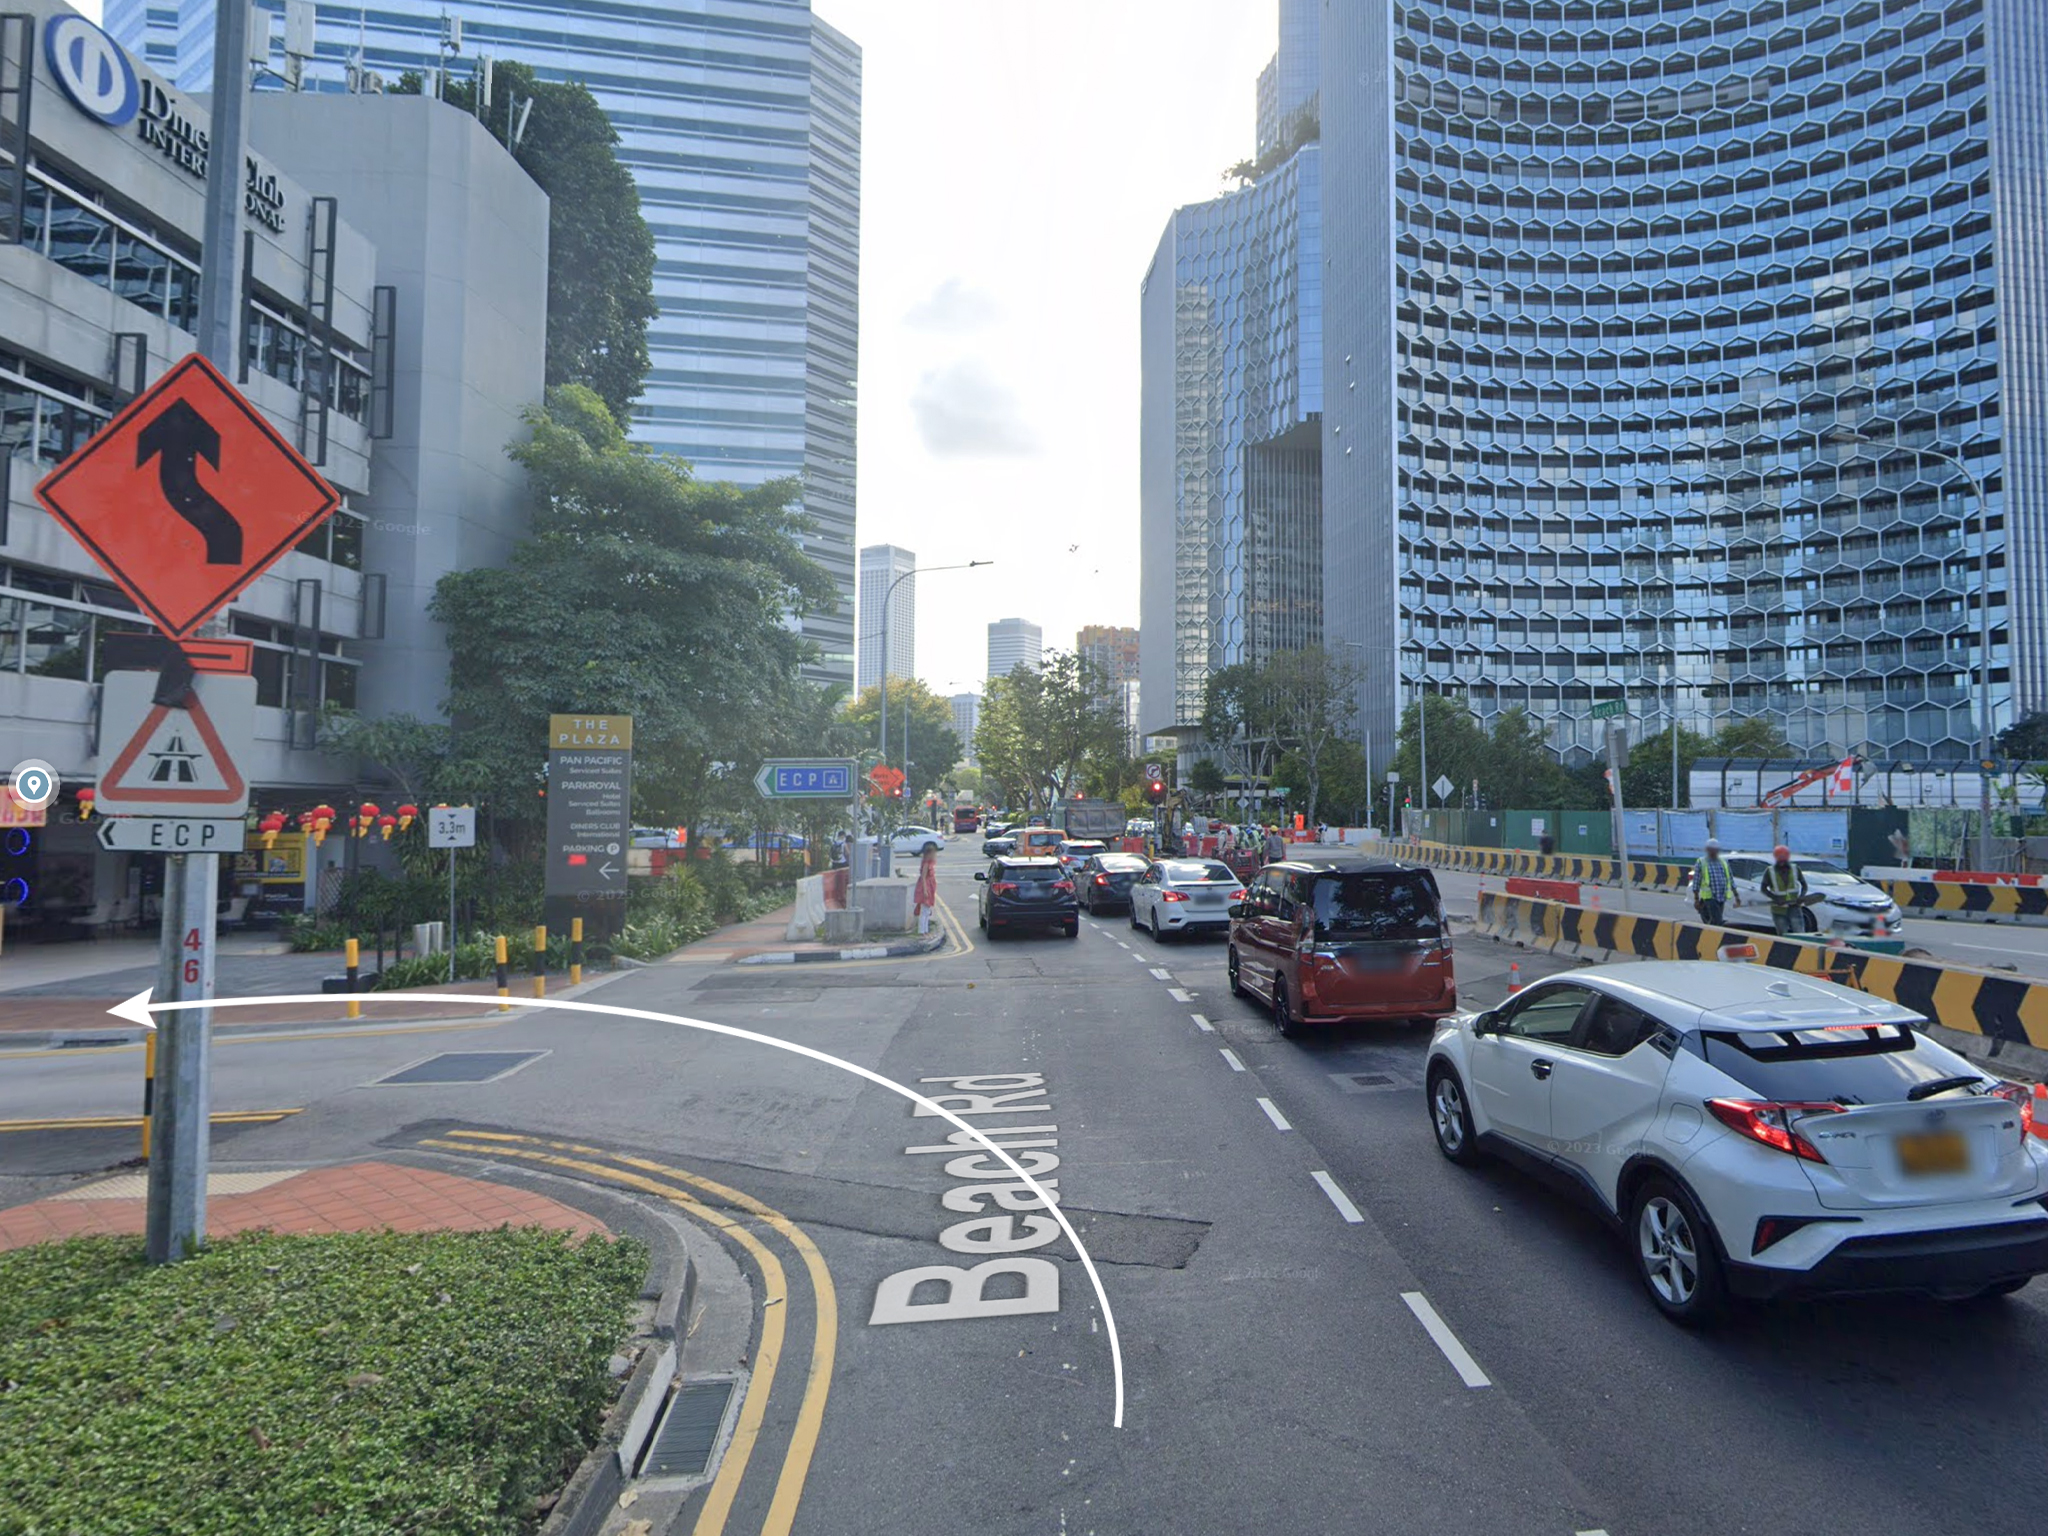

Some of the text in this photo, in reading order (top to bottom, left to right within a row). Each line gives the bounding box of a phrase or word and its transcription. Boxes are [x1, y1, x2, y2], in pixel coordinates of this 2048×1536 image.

[574, 719, 608, 730] THE
[559, 733, 620, 745] PLAZA
[560, 756, 622, 766] PAN PACIFIC
[780, 772, 817, 787] ECP
[562, 781, 621, 790] PARKROYAL
[438, 821, 466, 835] 3.3m
[570, 823, 620, 831] DINERS CLUB
[151, 824, 215, 847] ECP
[562, 844, 604, 853] PARKING
[868, 1072, 1061, 1325] Beach Rd
